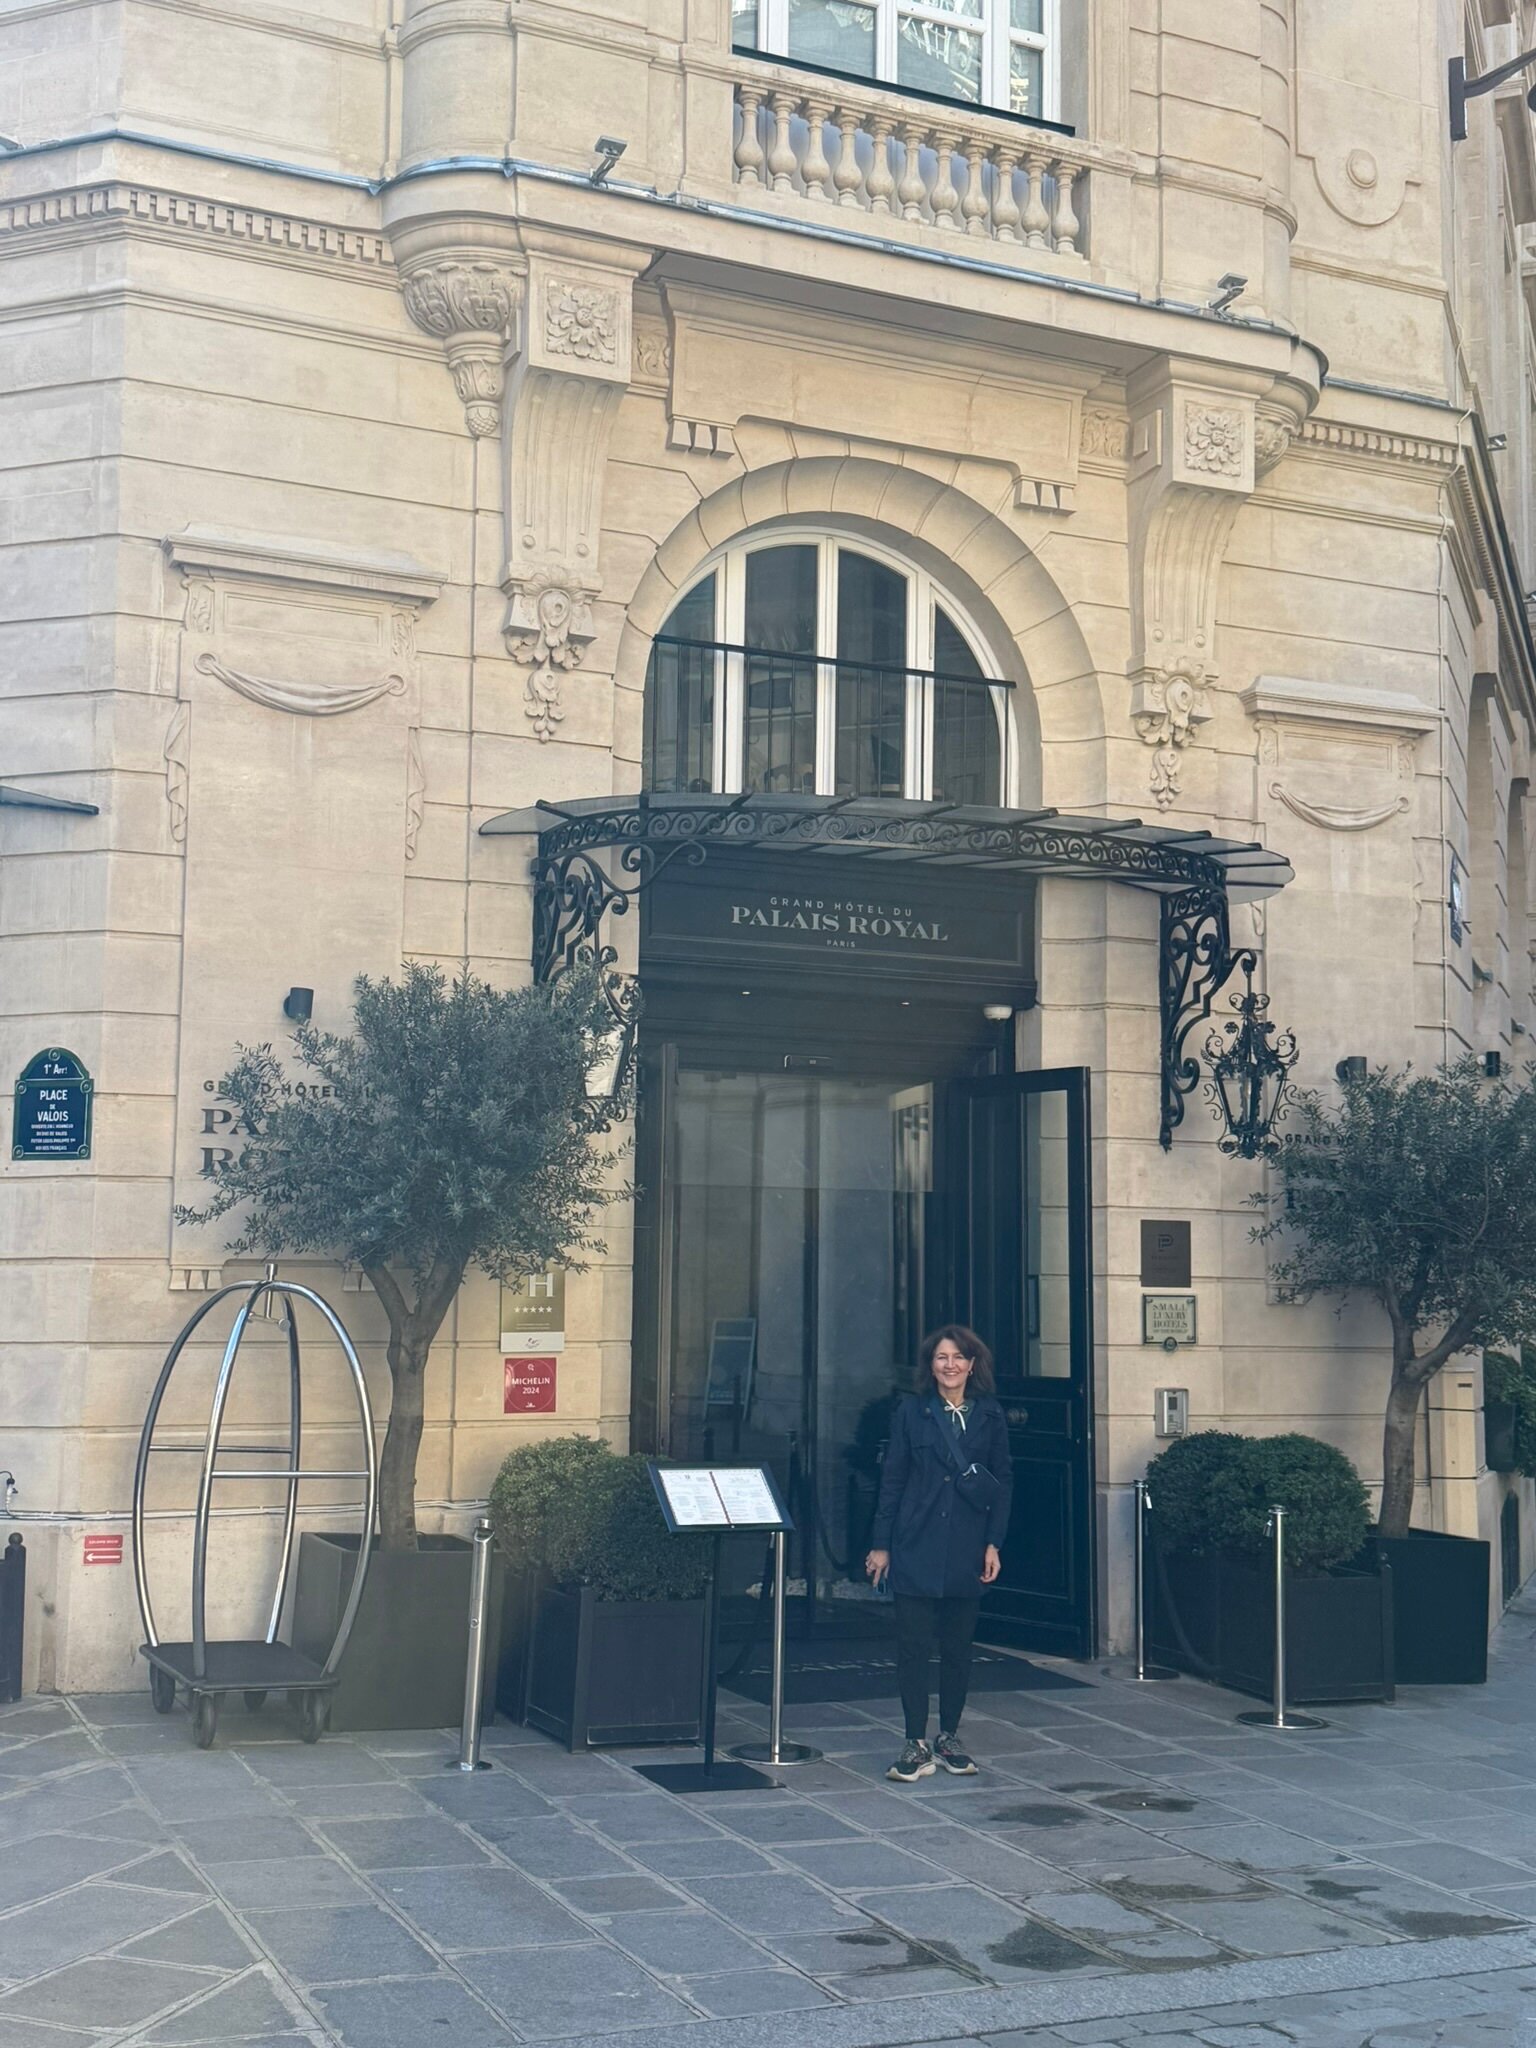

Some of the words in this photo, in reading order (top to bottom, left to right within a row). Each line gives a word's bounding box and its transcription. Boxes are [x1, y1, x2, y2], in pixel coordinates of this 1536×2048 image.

[770, 897, 824, 909] GRAND
[834, 901, 884, 914] HÔTEL
[893, 907, 912, 917] DU
[731, 906, 840, 932] PALAIS
[848, 916, 948, 941] ROYAL
[826, 939, 856, 948] PARIS
[203, 1080, 272, 1096] GRD
[40, 1089, 68, 1101] PLACE
[37, 1111, 69, 1122] VALOIS
[528, 1272, 553, 1297] H
[1152, 1303, 1187, 1311] SMALL
[1153, 1311, 1187, 1320] LUXURY
[1153, 1319, 1188, 1328] HOTELS
[512, 1377, 551, 1385] MICHELIN
